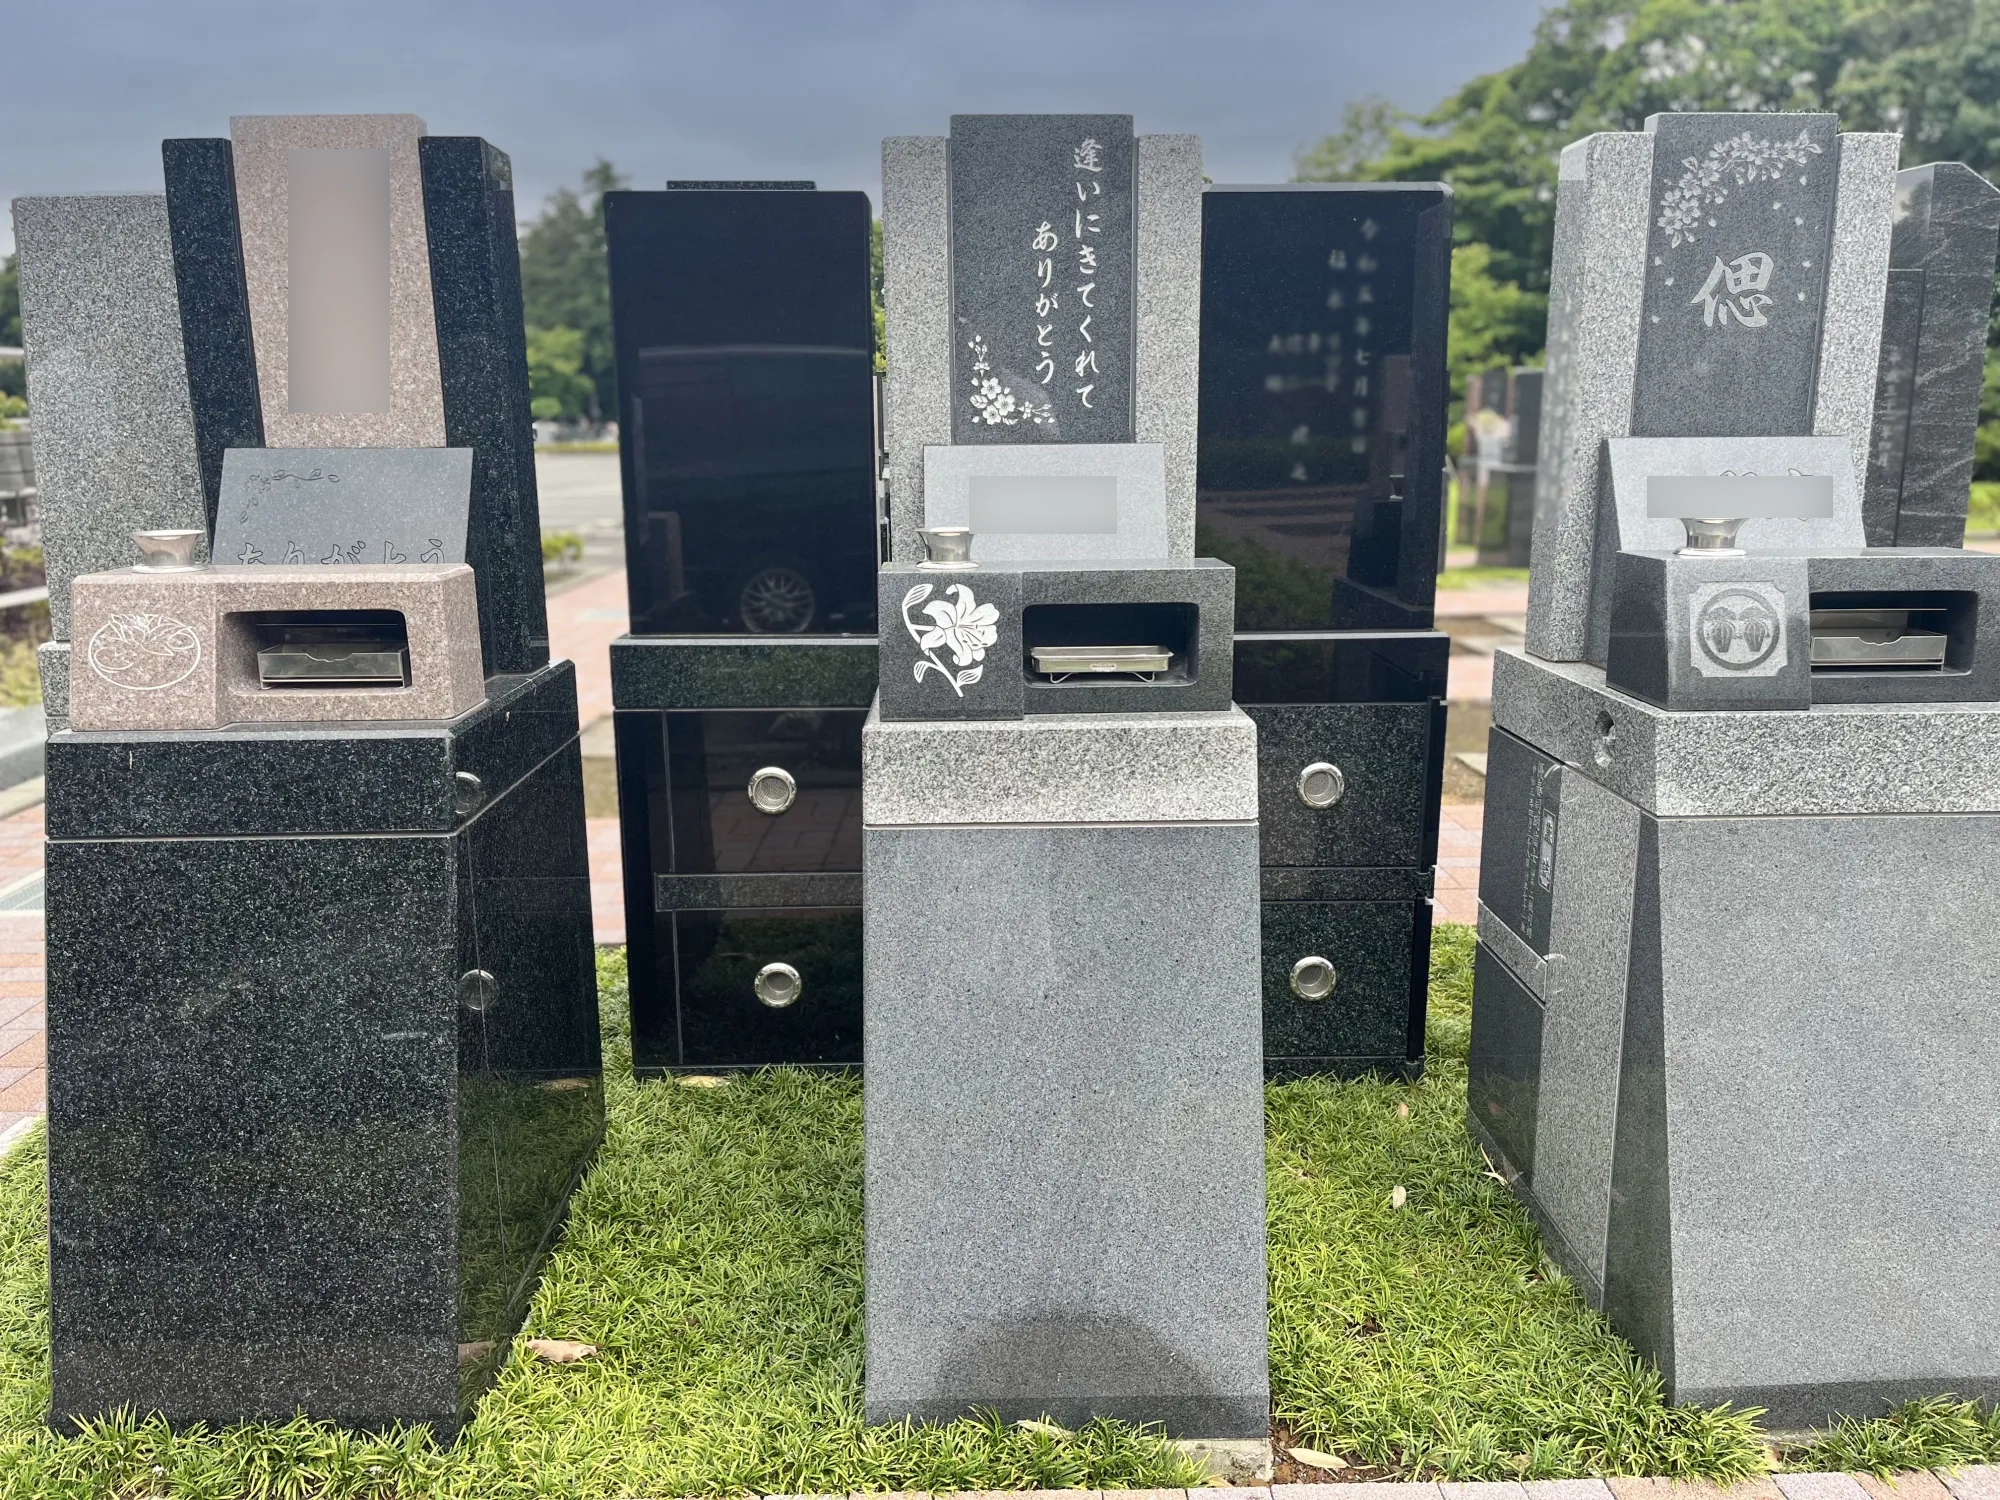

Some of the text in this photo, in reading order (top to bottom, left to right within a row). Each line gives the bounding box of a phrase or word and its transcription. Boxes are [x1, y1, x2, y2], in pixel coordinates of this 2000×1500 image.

[1032, 220, 1059, 384] ありがとう
[1073, 137, 1103, 408] 逢いにきてくれて
[1690, 251, 1775, 328] 偲
